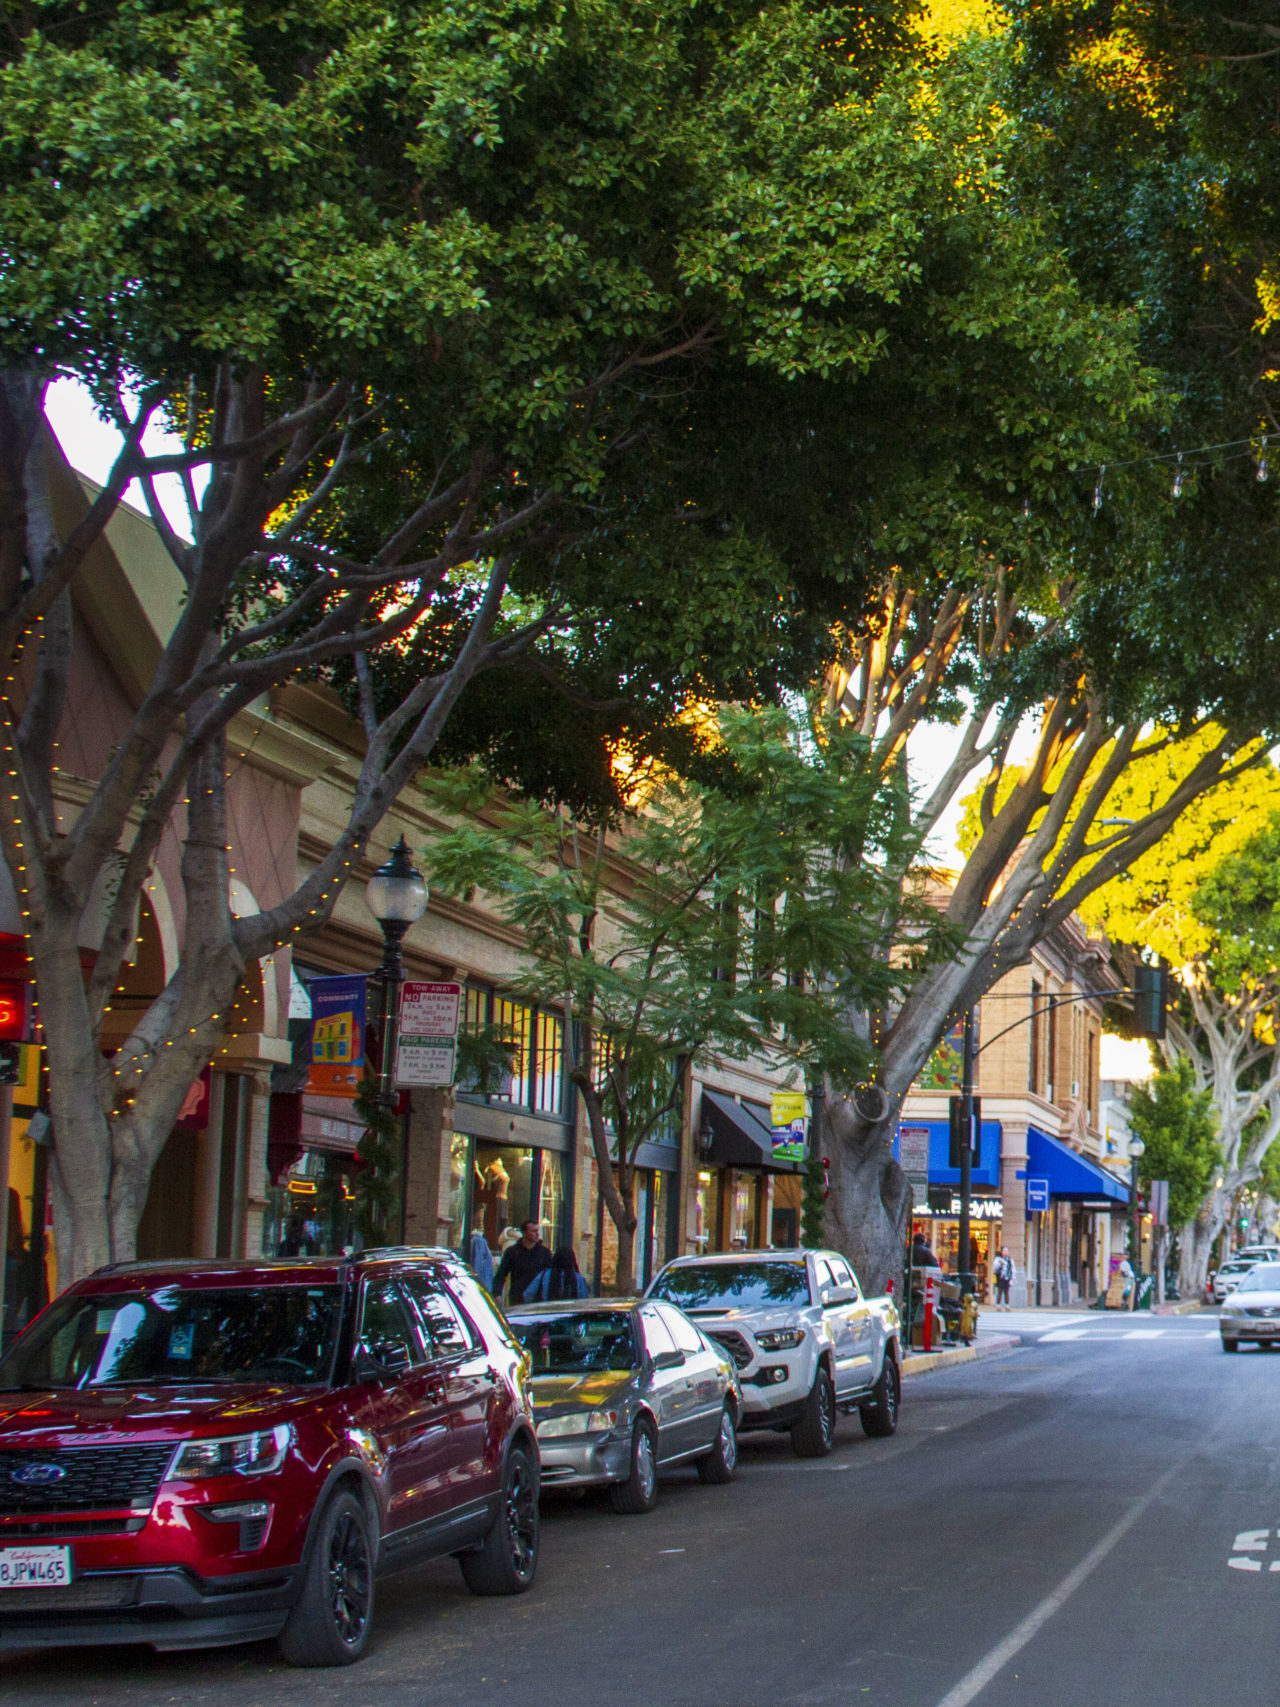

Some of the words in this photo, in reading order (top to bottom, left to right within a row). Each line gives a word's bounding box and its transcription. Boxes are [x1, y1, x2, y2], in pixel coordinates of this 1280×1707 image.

[412, 984, 452, 993] TOW-AWAY
[317, 994, 359, 1002] COMMUNITY
[405, 992, 420, 1002] NO
[423, 994, 455, 1003] PARKING
[9, 1550, 56, 1562] California
[0, 1562, 64, 1581] 8JPW465
